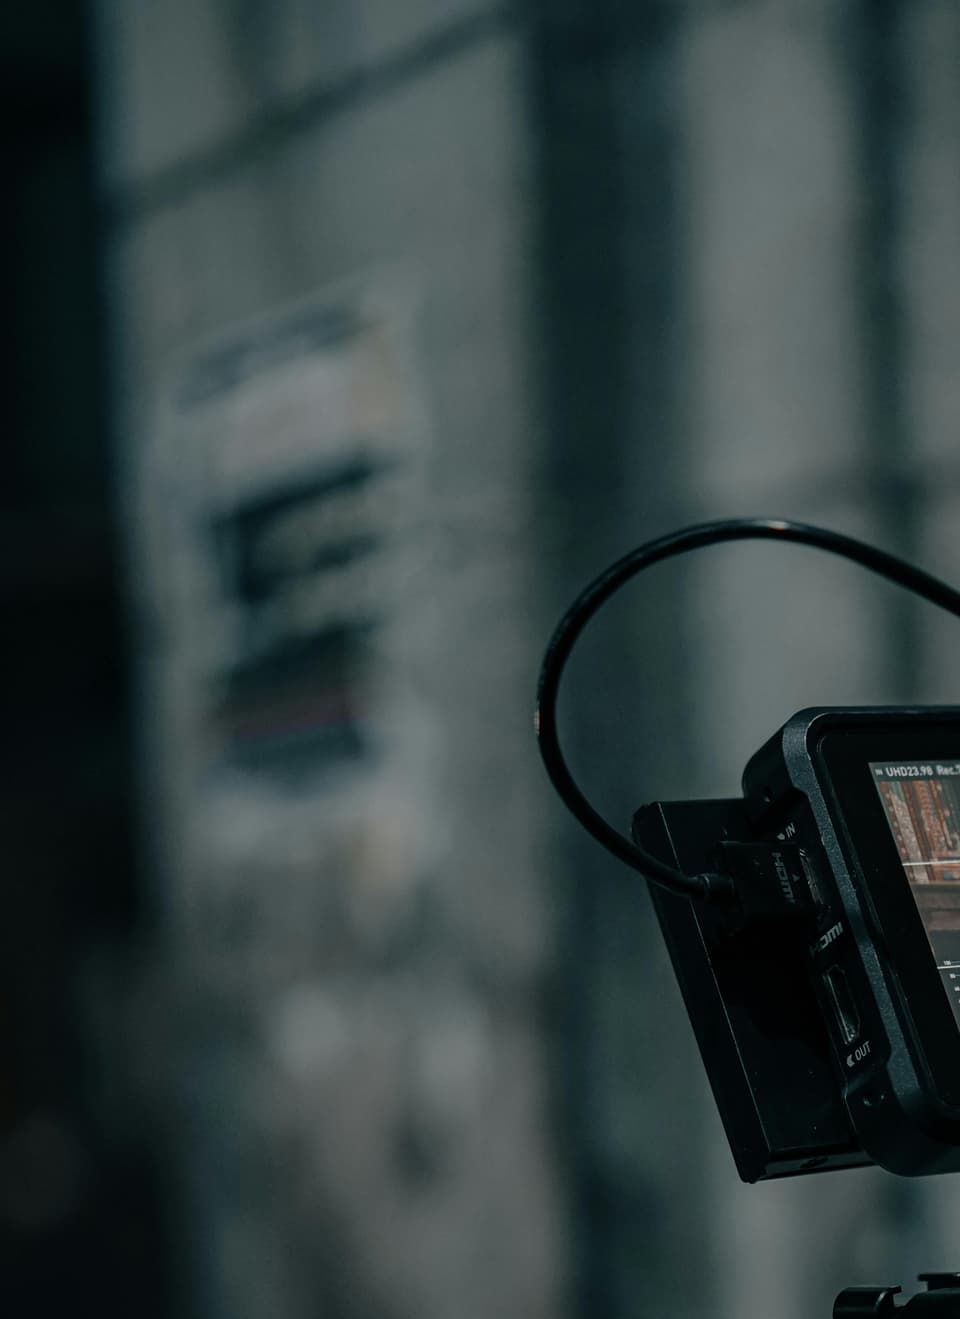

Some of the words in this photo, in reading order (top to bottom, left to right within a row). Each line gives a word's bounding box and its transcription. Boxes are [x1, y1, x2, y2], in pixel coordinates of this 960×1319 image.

[885, 764, 934, 777] UHD23.98
[784, 822, 796, 839] IN
[854, 1040, 872, 1062] OUT
